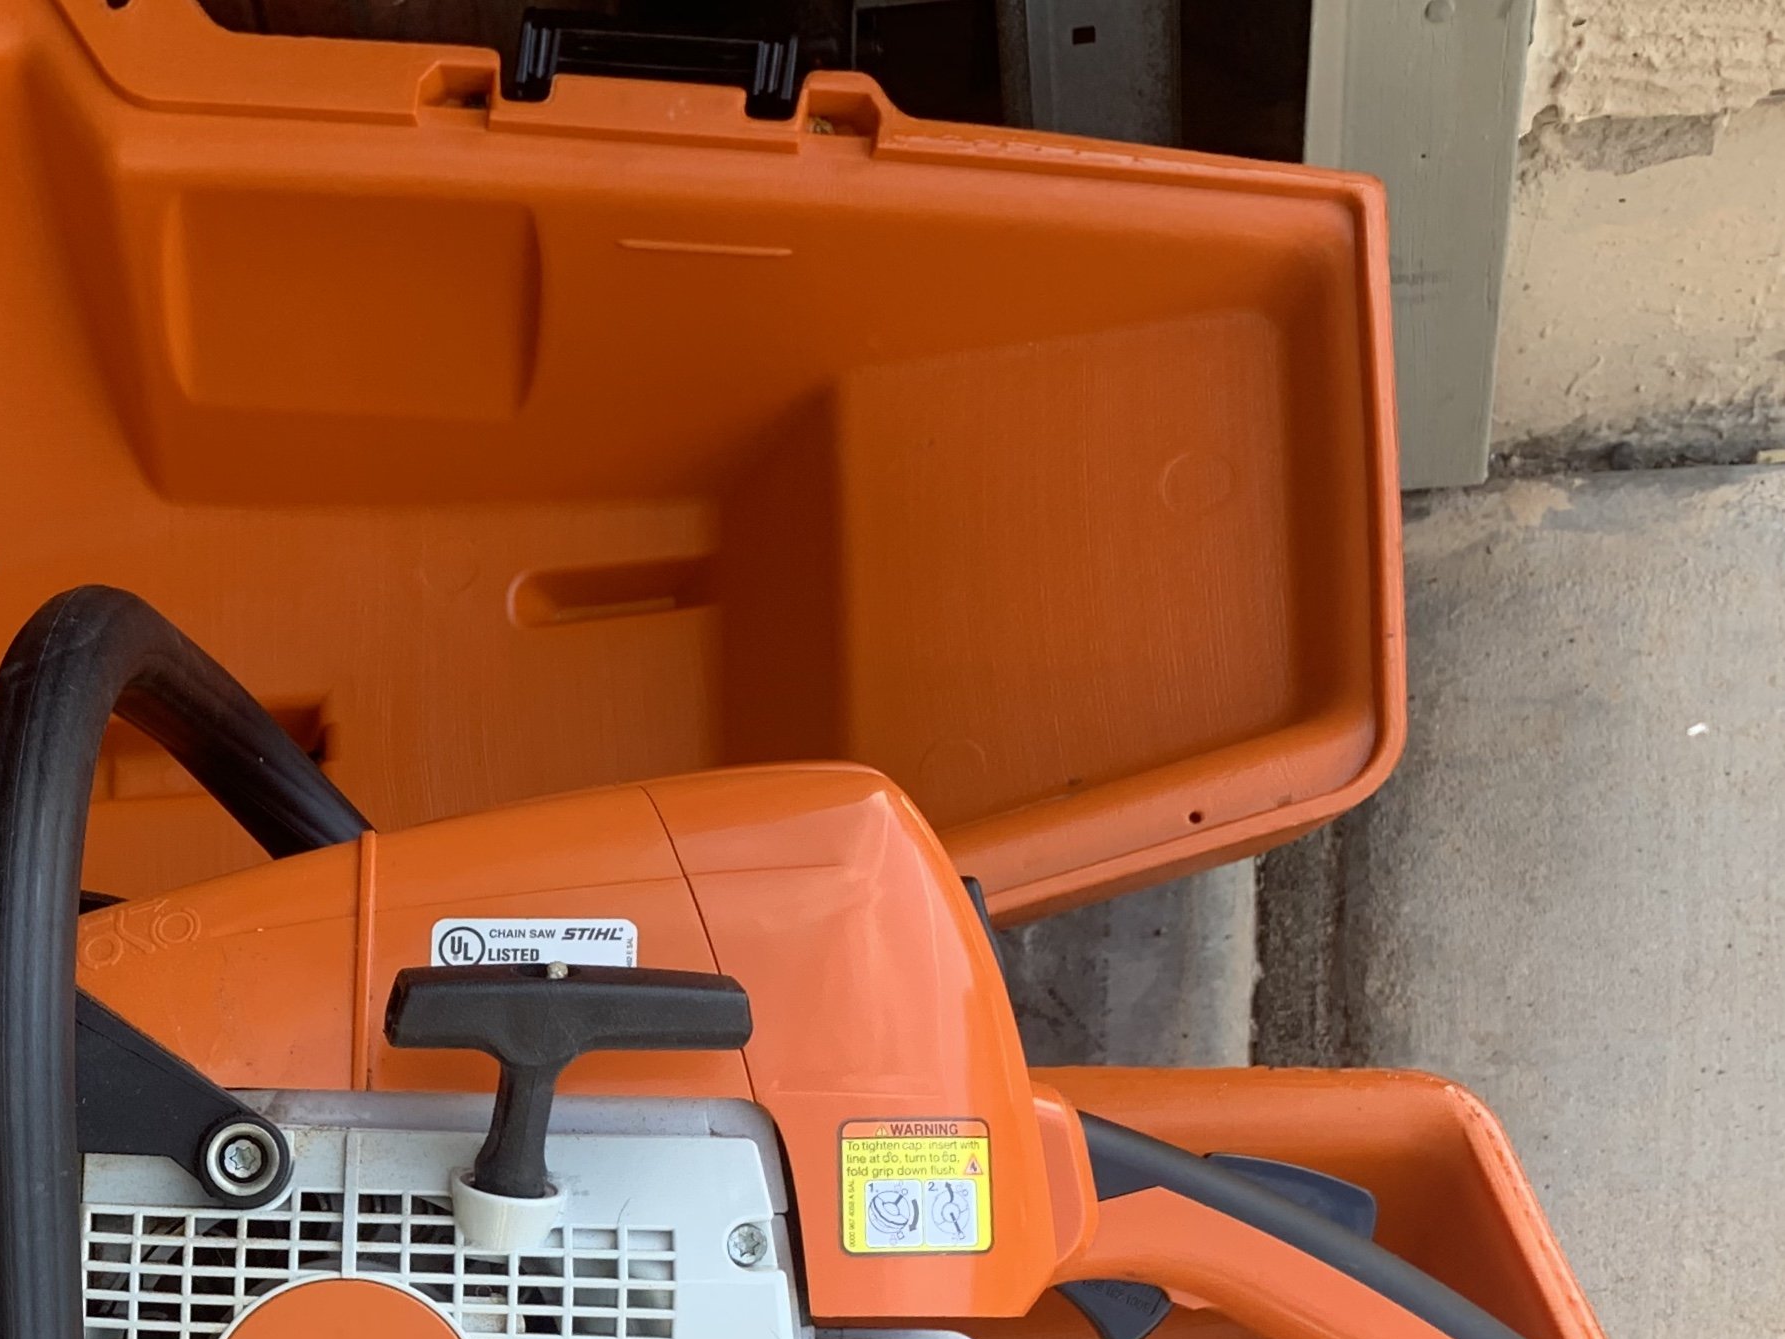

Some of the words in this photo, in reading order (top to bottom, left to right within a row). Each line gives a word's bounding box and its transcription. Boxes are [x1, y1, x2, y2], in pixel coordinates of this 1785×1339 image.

[489, 928, 526, 939] CHAIN
[529, 928, 556, 939] SAW
[450, 935, 474, 961] UL
[488, 947, 540, 962] LISTED
[890, 1123, 959, 1136] WARNING
[846, 1140, 860, 1151] To
[862, 1140, 900, 1153] tighten
[928, 1141, 957, 1150] insert
[960, 1140, 980, 1150] with
[846, 1154, 867, 1164] line
[869, 1154, 880, 1163] at
[905, 1154, 927, 1163] turn
[929, 1153, 941, 1163] to
[846, 1166, 869, 1176] fold
[872, 1168, 894, 1179] grip
[897, 1165, 928, 1175] down
